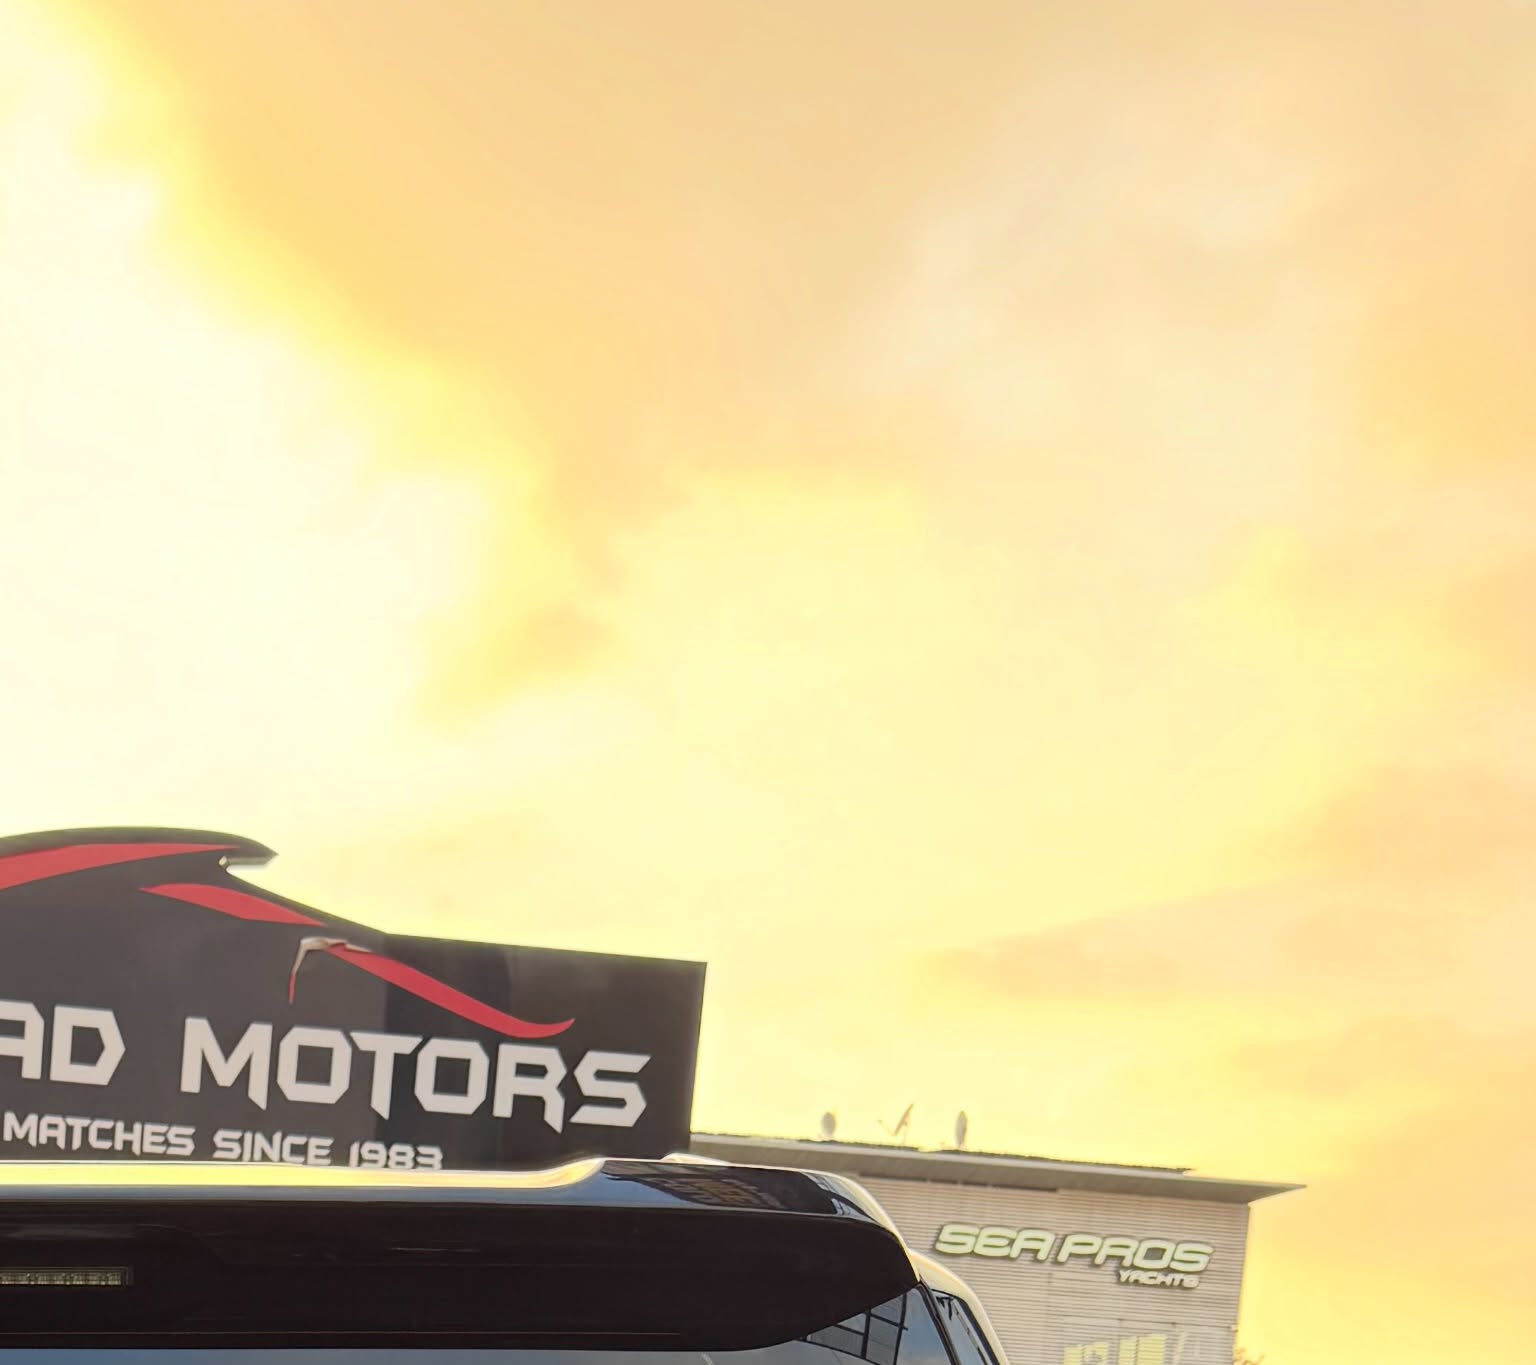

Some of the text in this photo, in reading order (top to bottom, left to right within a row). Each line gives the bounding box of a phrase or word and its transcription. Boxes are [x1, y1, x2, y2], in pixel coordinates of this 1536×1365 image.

[180, 1015, 651, 1133] MOTORS
[3, 1111, 195, 1156] MATCHES
[212, 1129, 333, 1167] SINCE
[349, 1141, 443, 1170] 1983
[935, 1224, 1056, 1261] SEA
[1118, 1269, 1200, 1289] YACHTS
